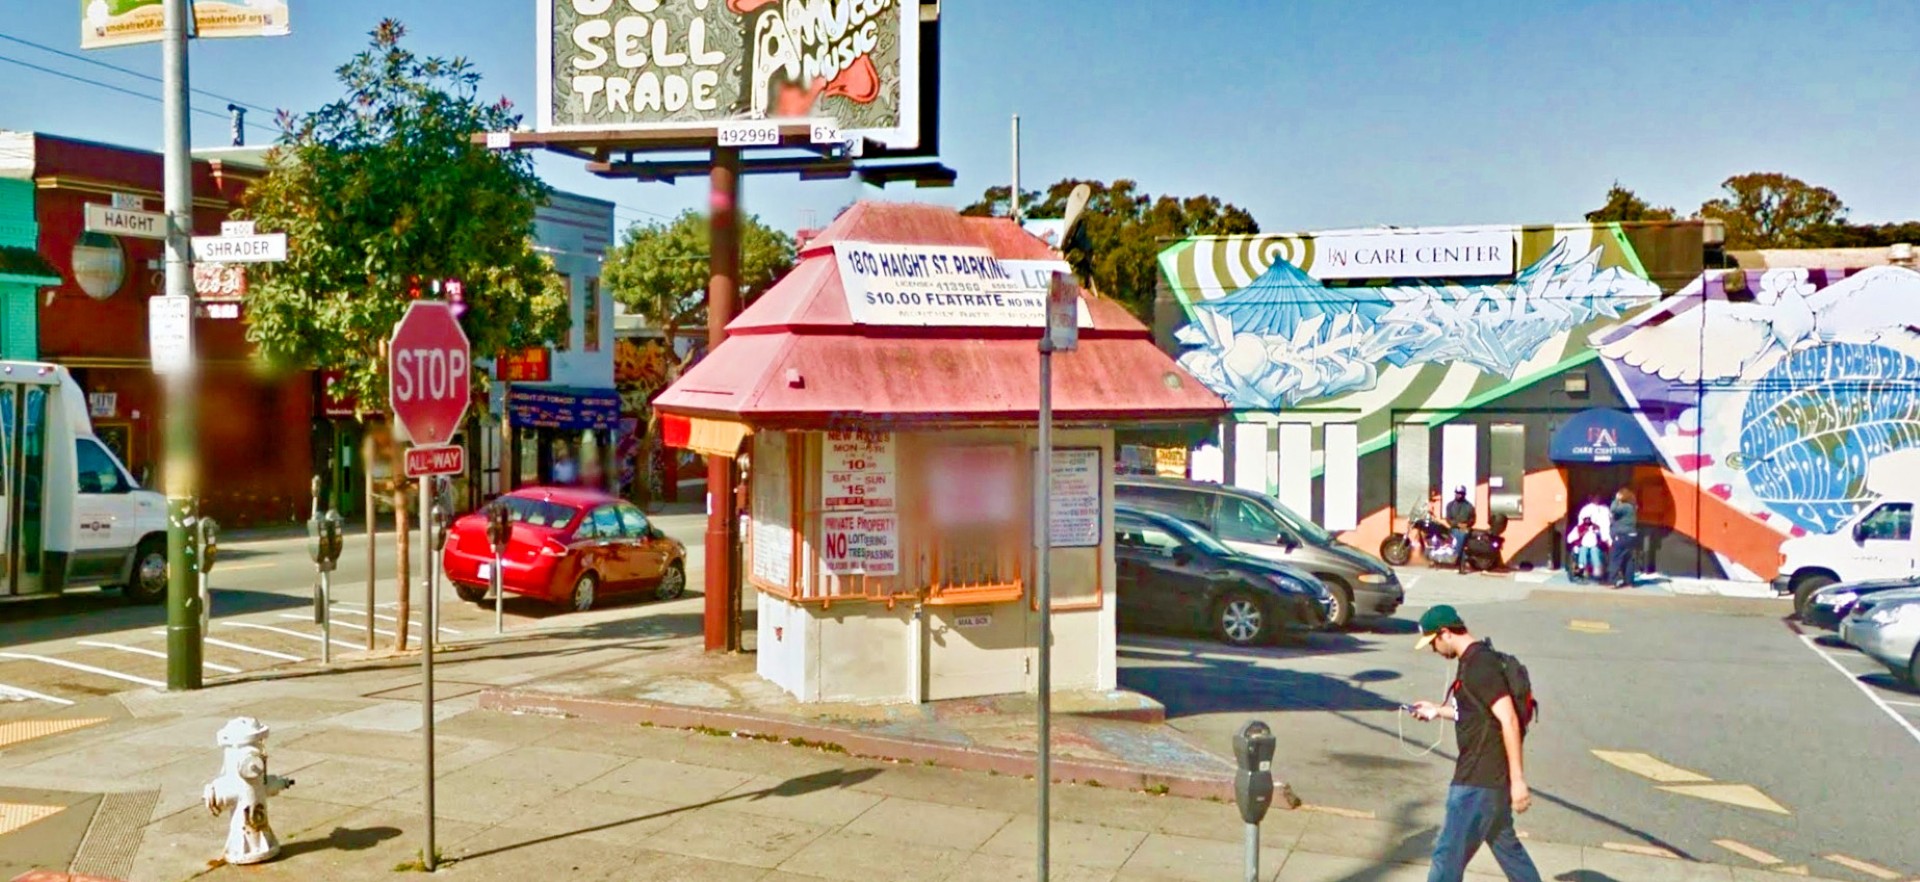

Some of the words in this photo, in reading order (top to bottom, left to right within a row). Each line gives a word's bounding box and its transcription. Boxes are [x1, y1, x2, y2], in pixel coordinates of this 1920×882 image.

[572, 16, 726, 70] SELL
[803, 20, 878, 88] MUSIC
[572, 70, 719, 113] TRADE
[720, 128, 777, 143] 492996
[104, 211, 155, 232] HAIGHT
[206, 240, 270, 257] SHRADER
[1354, 249, 1408, 264] CARE
[1415, 246, 1502, 263] CENTER
[879, 252, 931, 279] HAIGHT
[1020, 268, 1053, 289] LO
[866, 291, 921, 305] $10.00
[925, 293, 1005, 307] FLATRATE
[1008, 299, 1021, 307] NO
[1023, 299, 1034, 307] IN
[397, 348, 465, 401] STOP
[828, 430, 851, 441] NEW
[833, 444, 857, 452] MON
[409, 452, 460, 471] ALL-WAY
[832, 474, 852, 483] SAT
[865, 476, 886, 484] SUN
[826, 533, 847, 559] NO
[848, 534, 887, 546] LOITERING
[848, 548, 894, 559] TRESPASSING
